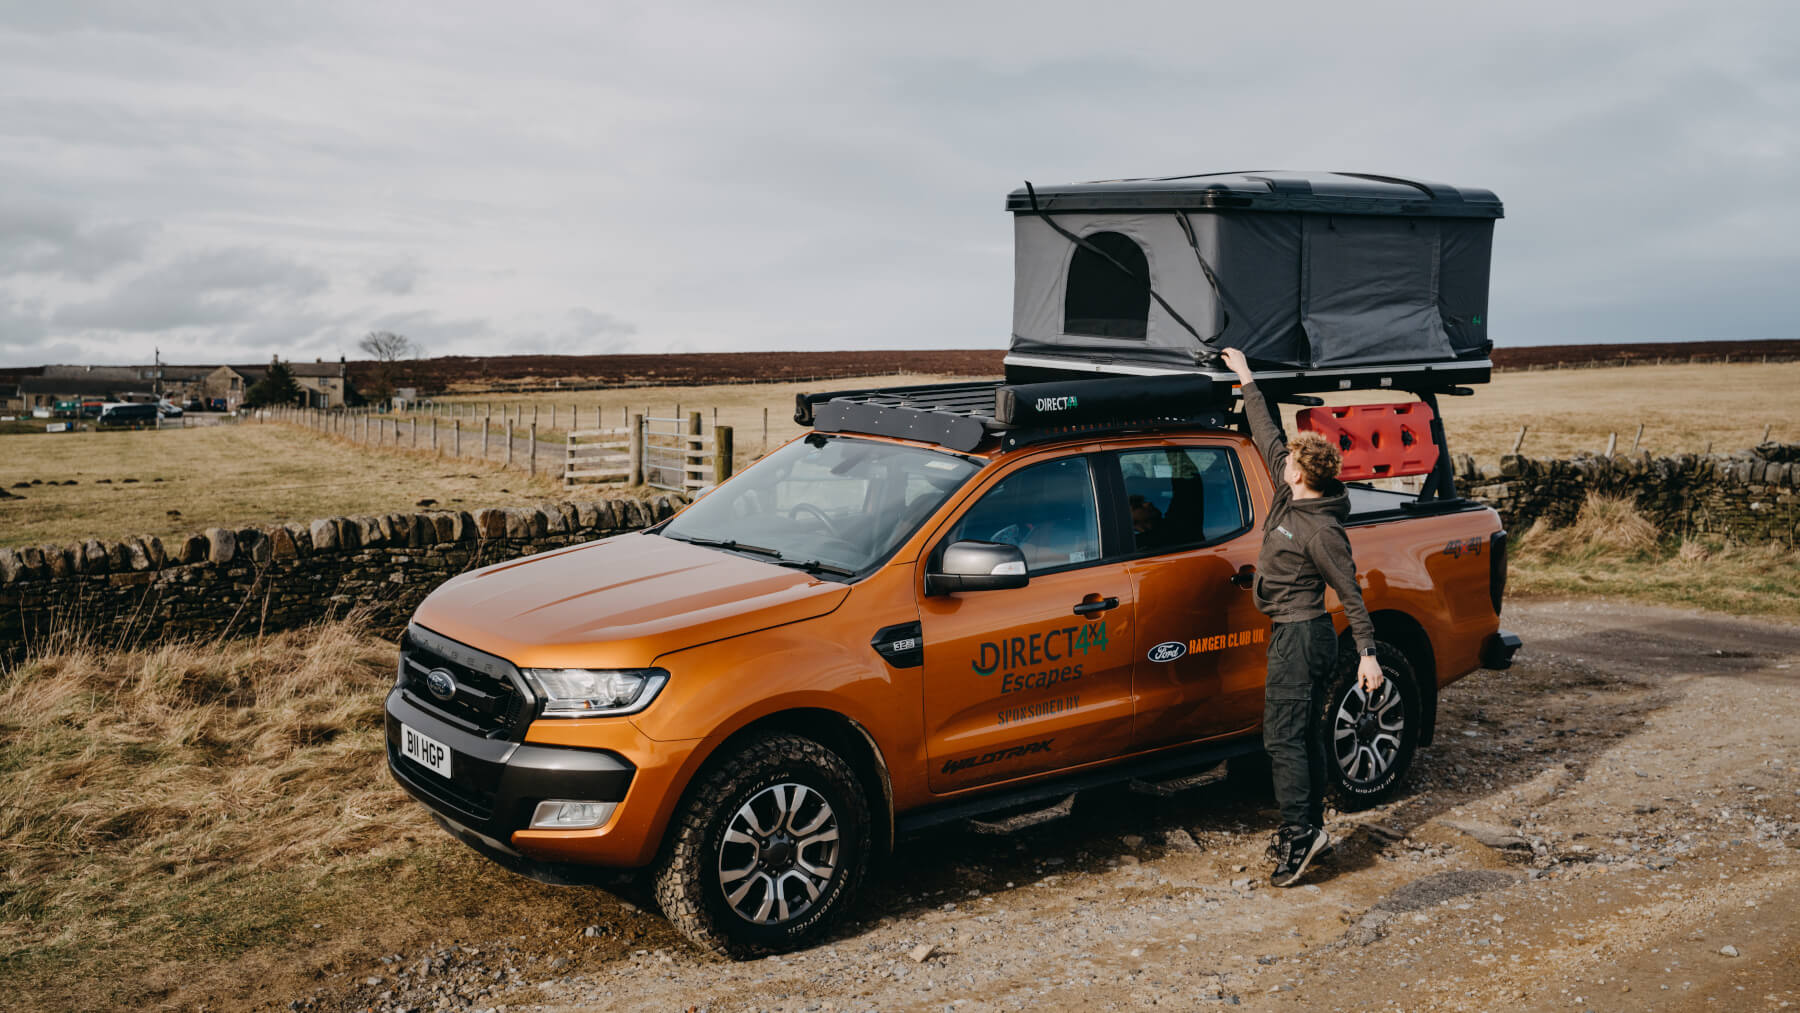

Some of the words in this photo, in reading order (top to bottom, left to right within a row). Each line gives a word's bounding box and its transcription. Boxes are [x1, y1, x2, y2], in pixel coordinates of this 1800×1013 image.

[1154, 644, 1180, 660] Ford
[1227, 631, 1251, 648] CLUB
[1252, 628, 1265, 644] UK
[1000, 663, 1084, 694] Escapes
[422, 738, 444, 768] HGP
[941, 738, 1055, 775] WILDTRAK
